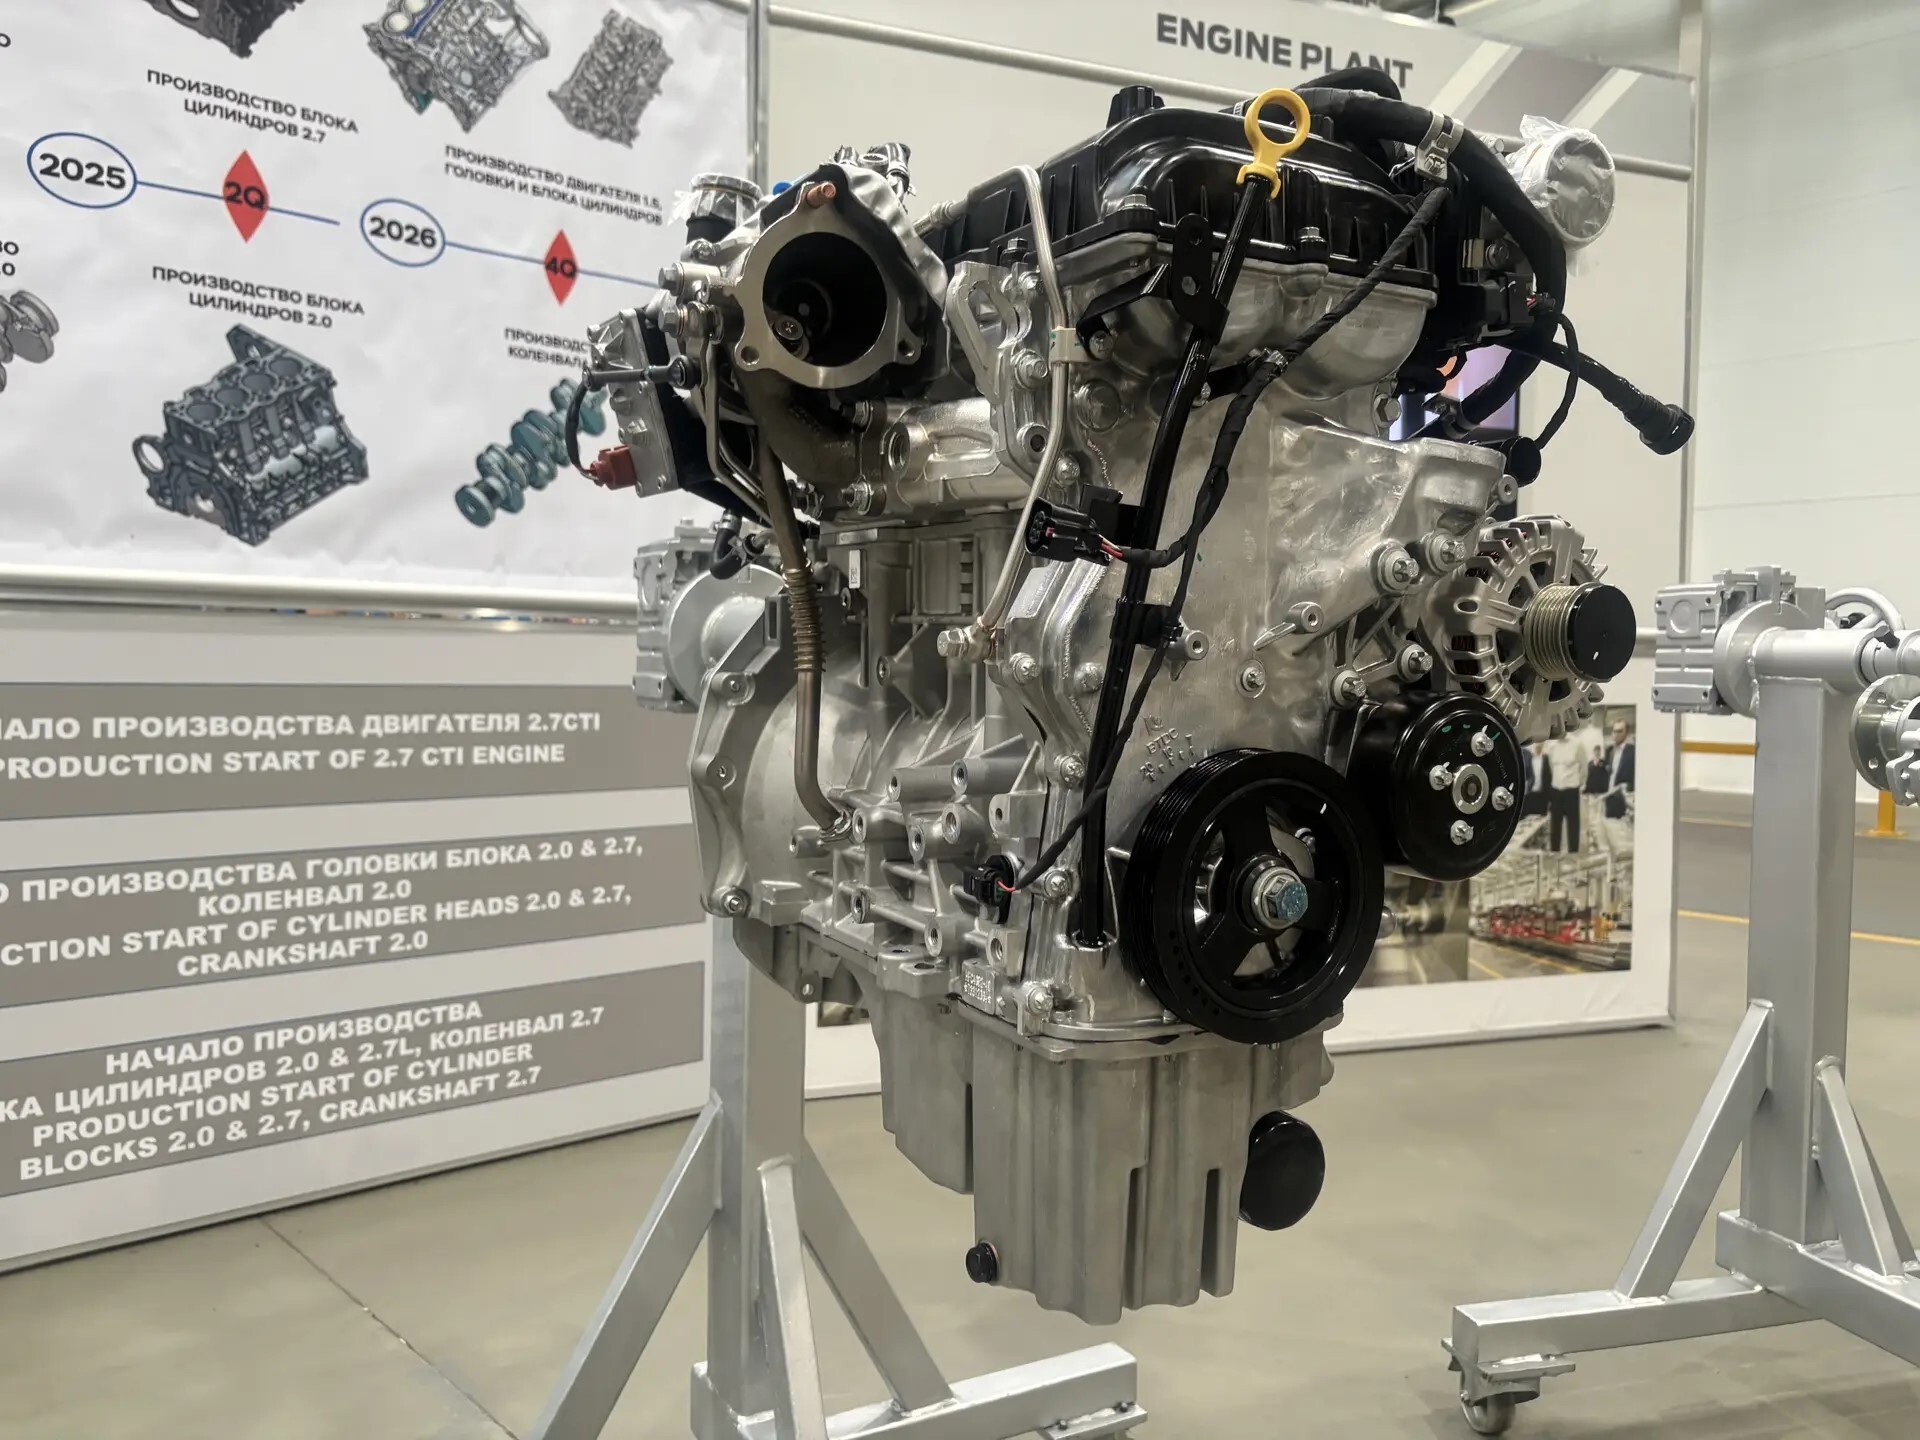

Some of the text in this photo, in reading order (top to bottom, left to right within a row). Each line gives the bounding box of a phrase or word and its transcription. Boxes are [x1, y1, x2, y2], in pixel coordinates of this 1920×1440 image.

[1156, 13, 1413, 89] ENGINE PLANT
[147, 69, 358, 134] ПРОИЗВОДСТВО БЛОКА
[183, 99, 326, 143] ЦИЛИНДРОВ 2.7
[39, 153, 126, 190] 2025
[445, 145, 563, 184] ПРОИЗВОДСТВО
[566, 176, 641, 204] ДВИГАТЕЛЯ
[445, 163, 662, 226] ГОЛОВКИ И БЛОКА ЦИЛИНДРОВ
[225, 181, 267, 211] 2Q
[369, 217, 437, 249] 2026
[152, 266, 365, 315] ПРОИЗВОДСТВО БЛОКА
[545, 257, 576, 280] 4Q
[189, 292, 332, 328] ЦИЛИНДРОВ 2.0
[505, 327, 591, 353] ПРОИЗВОДС
[0, 712, 600, 740] АЛО ПРОИЗВОДСТВА ДВИГАТЕЛЯ 2.7CTI
[0, 744, 565, 780] RODUCTION START OF 2.7 CTI ENGINE
[22, 861, 297, 902] ПРОИЗВОДСТВА
[306, 851, 438, 879] ГОЛОВКИ
[446, 845, 532, 868] БЛОКА
[538, 841, 573, 861] 2.0
[580, 839, 597, 857] &
[604, 836, 644, 857] 2.7,
[122, 923, 228, 954] START
[237, 918, 278, 942] OF
[287, 904, 427, 936] CYLINDER
[435, 895, 520, 922] HEADS
[526, 891, 561, 912] 2.0
[568, 889, 585, 907] &
[592, 884, 632, 905] 2.7,
[198, 879, 412, 917] КОЛЕНВАЛ 2.0
[177, 930, 428, 977] CRANKSHAFT 2.0
[55, 1060, 266, 1115] ЦИЛИНДРОВ
[276, 1052, 320, 1076] 2.0
[329, 1048, 349, 1067] &
[358, 1037, 422, 1063] 2.7L,
[430, 1013, 564, 1051] КОЛЕНВАЛ
[570, 1007, 605, 1028] 2.7
[106, 1001, 483, 1075] НАЧАЛО ПРОИЗВОДСТВА
[33, 1043, 533, 1148] PRODUCTION START OF CYLINDER
[20, 1066, 542, 1180] BLOCKS 2.0 & 2.7, CRANKSHAFT 2.7
